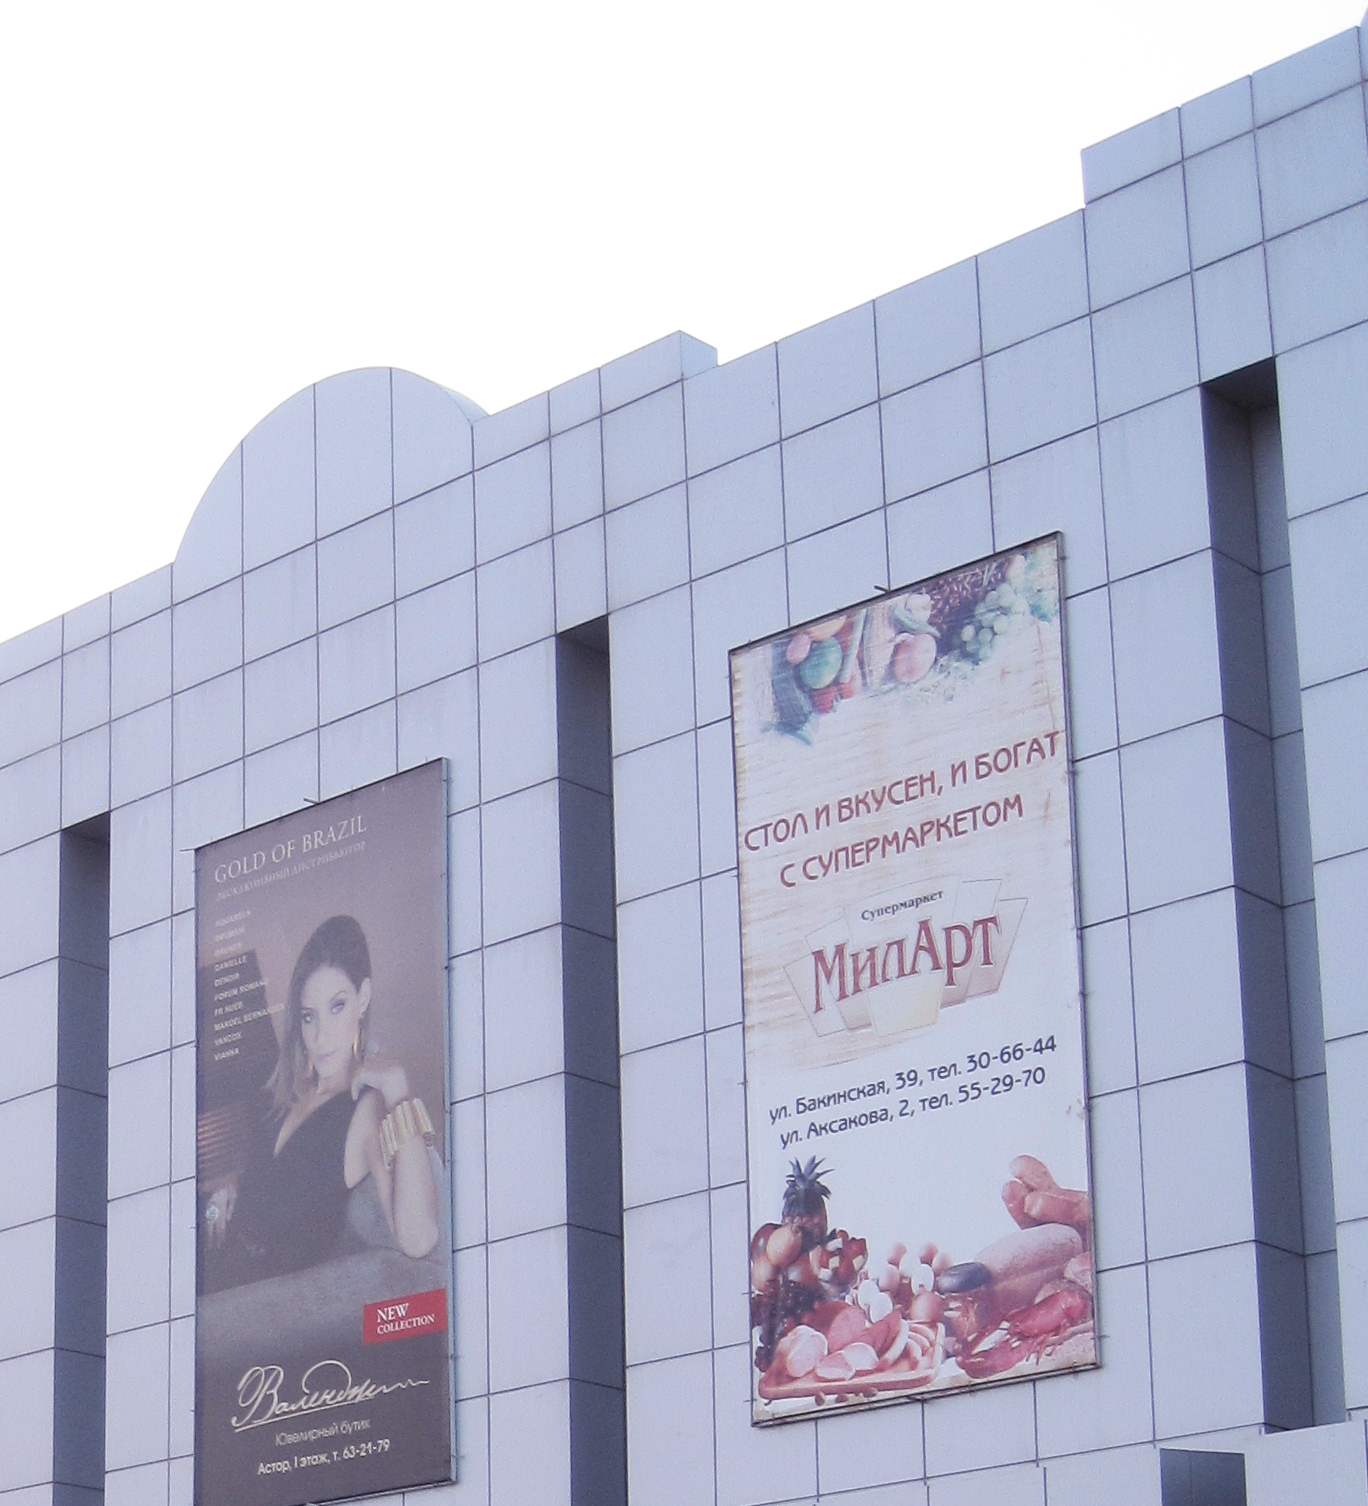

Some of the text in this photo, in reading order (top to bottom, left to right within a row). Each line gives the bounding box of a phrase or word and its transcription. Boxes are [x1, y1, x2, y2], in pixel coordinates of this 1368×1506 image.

[744, 731, 1060, 852] СТОЛ И ВКУСЕН, И БОГАТ
[214, 815, 367, 883] GOLD OF BRAZIL
[780, 794, 1024, 888] С СУПЕРМАРКЕТОМ
[860, 890, 944, 922] Супермаркет
[769, 1035, 1057, 1125] ул. Бакинская, 39, тел. 30-66-44
[780, 1067, 1046, 1149] ул. Аксакова, 2, тел. 55-29-70
[376, 1313, 435, 1335] COLLECTION
[377, 1302, 410, 1324] NEW
[257, 1458, 292, 1476] Астор,
[299, 1451, 331, 1469] этаж,
[342, 1439, 391, 1460] 63-21-79
[275, 1418, 371, 1446] Ювелирный бутик
